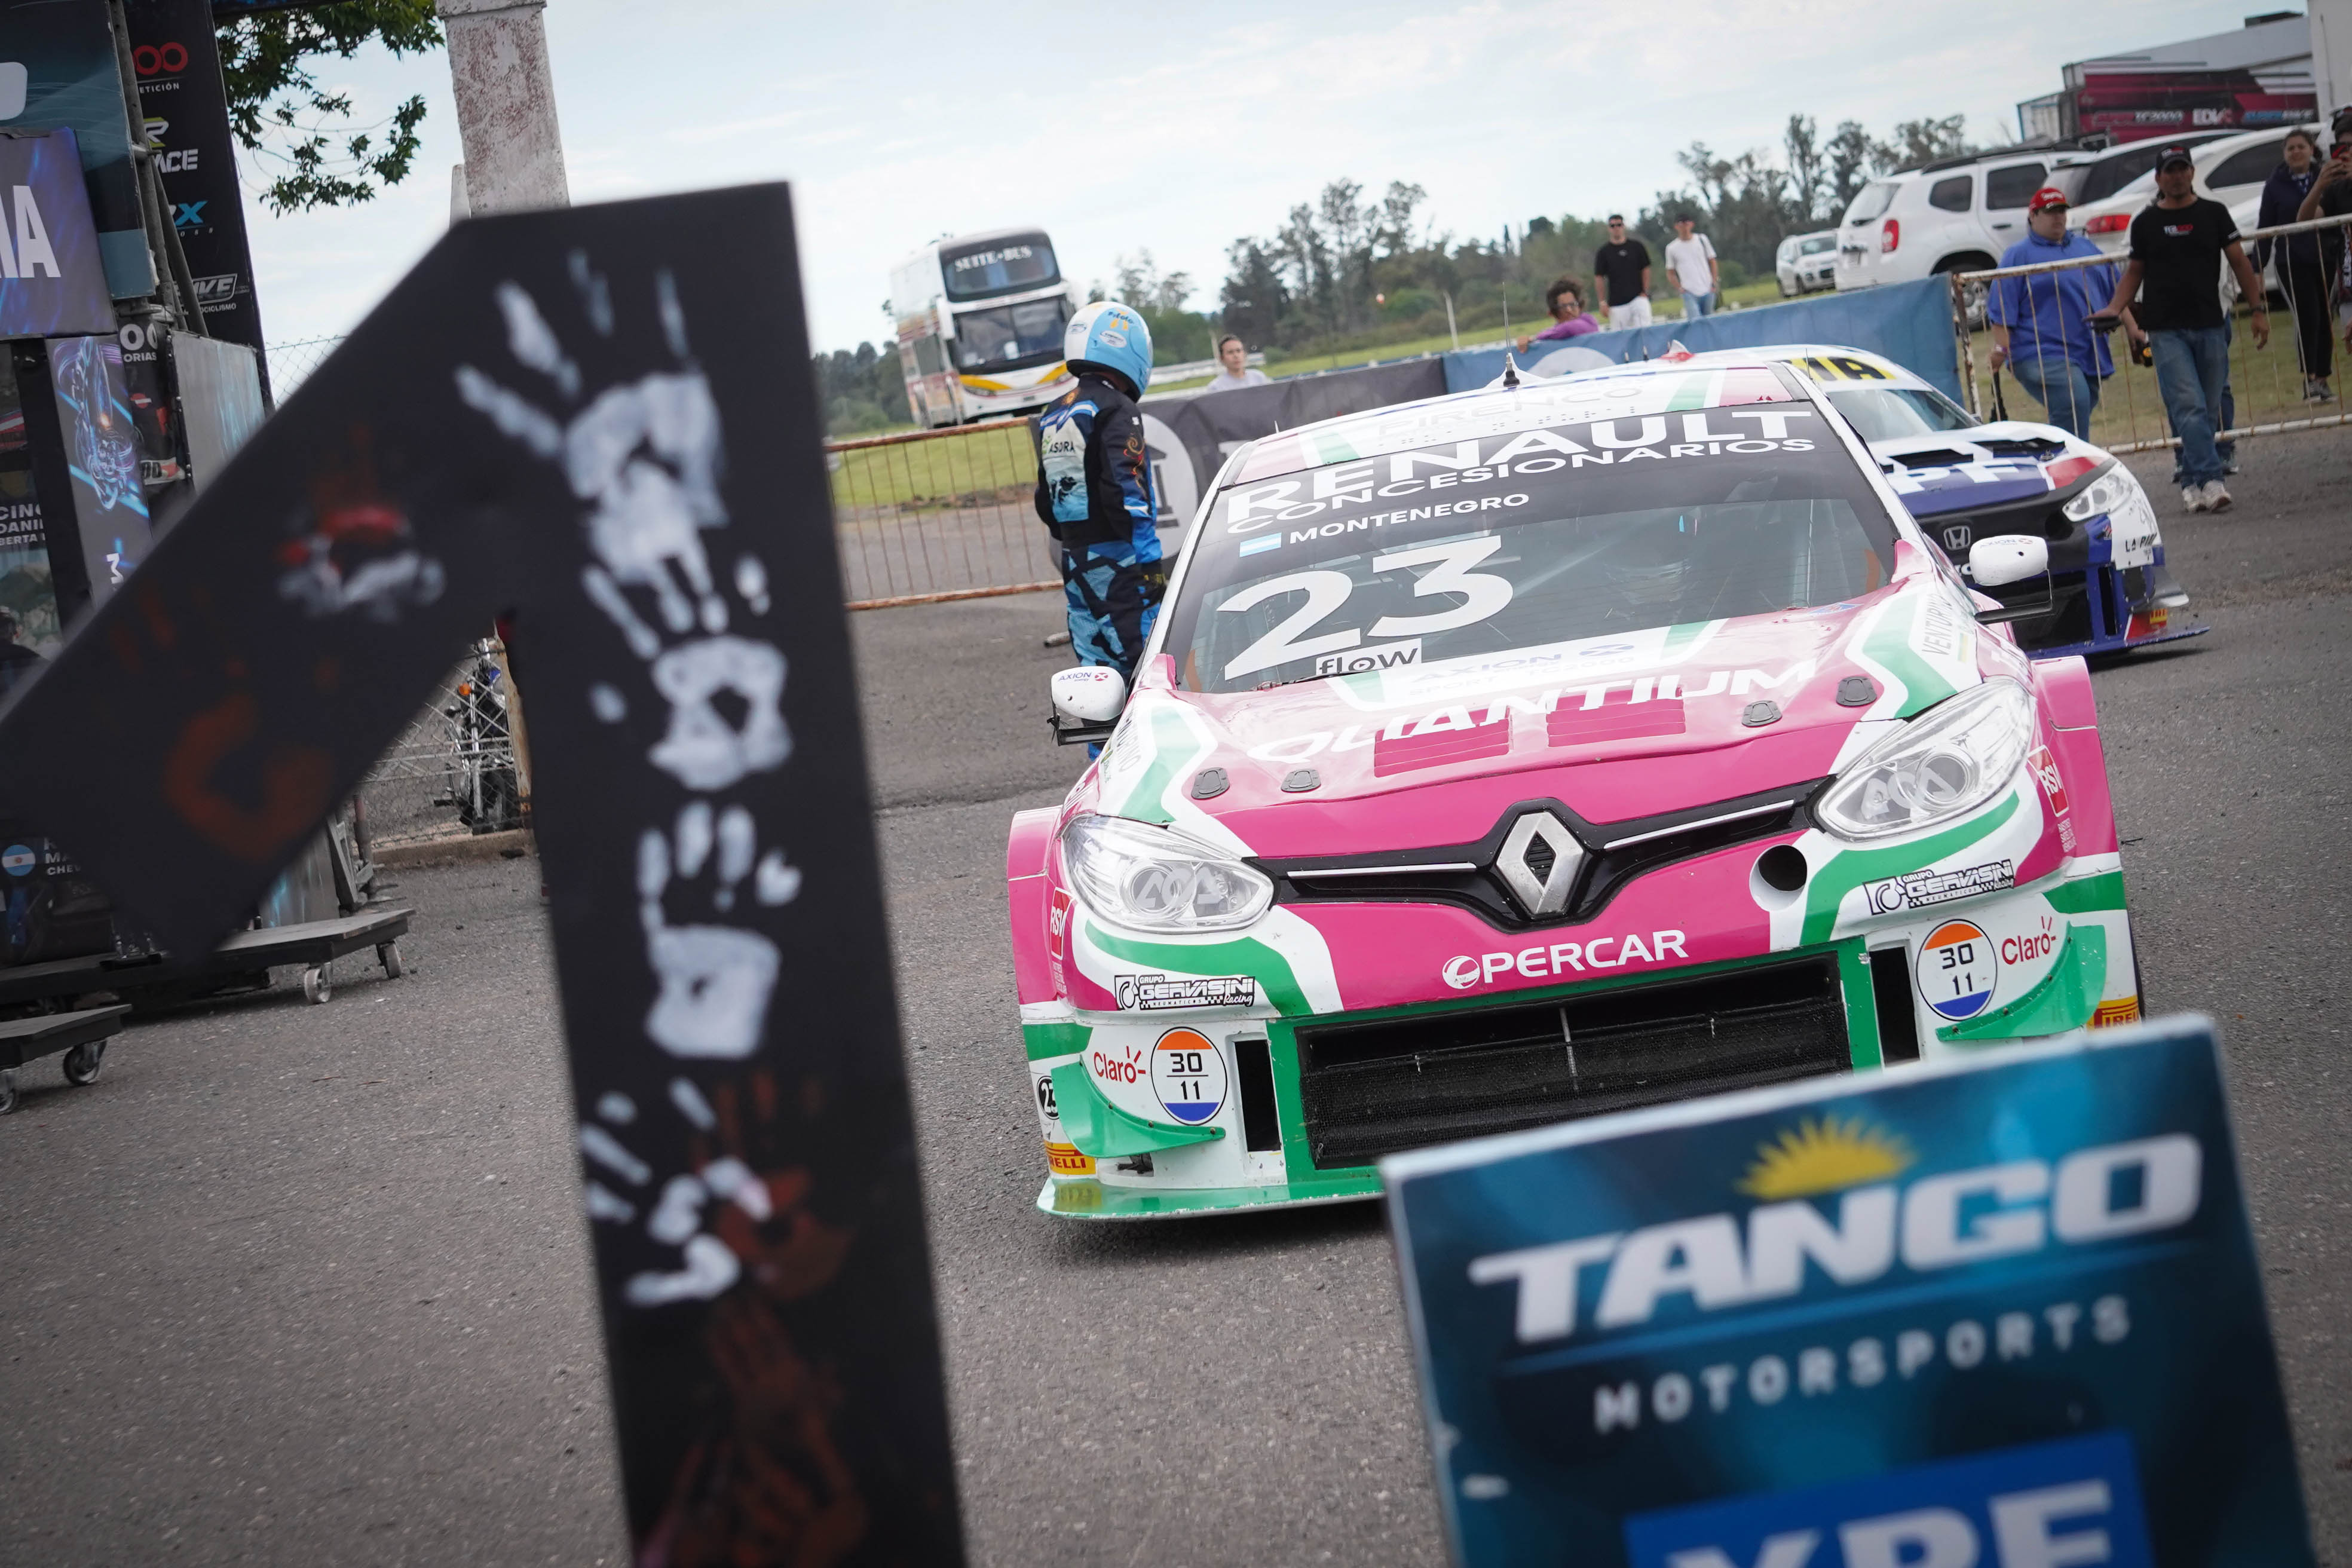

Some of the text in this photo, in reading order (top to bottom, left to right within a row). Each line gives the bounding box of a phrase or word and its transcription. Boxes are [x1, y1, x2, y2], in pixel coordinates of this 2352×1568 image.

[139, 82, 179, 94] ETICIÓN
[122, 351, 157, 362] ORIAS
[1227, 410, 1812, 523] RENAULT
[1227, 438, 1815, 534] CONCESIONARIOS
[1290, 494, 1530, 544] MONTENEGRO
[1216, 535, 1513, 681] 23
[1057, 672, 1092, 682] AXION
[1318, 648, 1419, 676] flow
[1411, 653, 1562, 683] AXION
[1246, 657, 1817, 765] QUANTIUM
[1903, 871, 1933, 883] GRUPO
[1905, 860, 2013, 898] GERVASINI
[1481, 929, 1689, 984] PERCAR
[1939, 932, 2051, 970] 30 Claro
[1139, 975, 1164, 984] GRUPO
[1139, 977, 1254, 1000] GERVASINI
[1952, 972, 1973, 996] 11
[1224, 993, 1254, 1006] Racing
[1094, 1051, 1203, 1084] Claro 30
[1181, 1080, 1200, 1100] 11
[1466, 1131, 2205, 1346] TANGO
[1593, 1293, 2133, 1435] MOTORSPORTS
